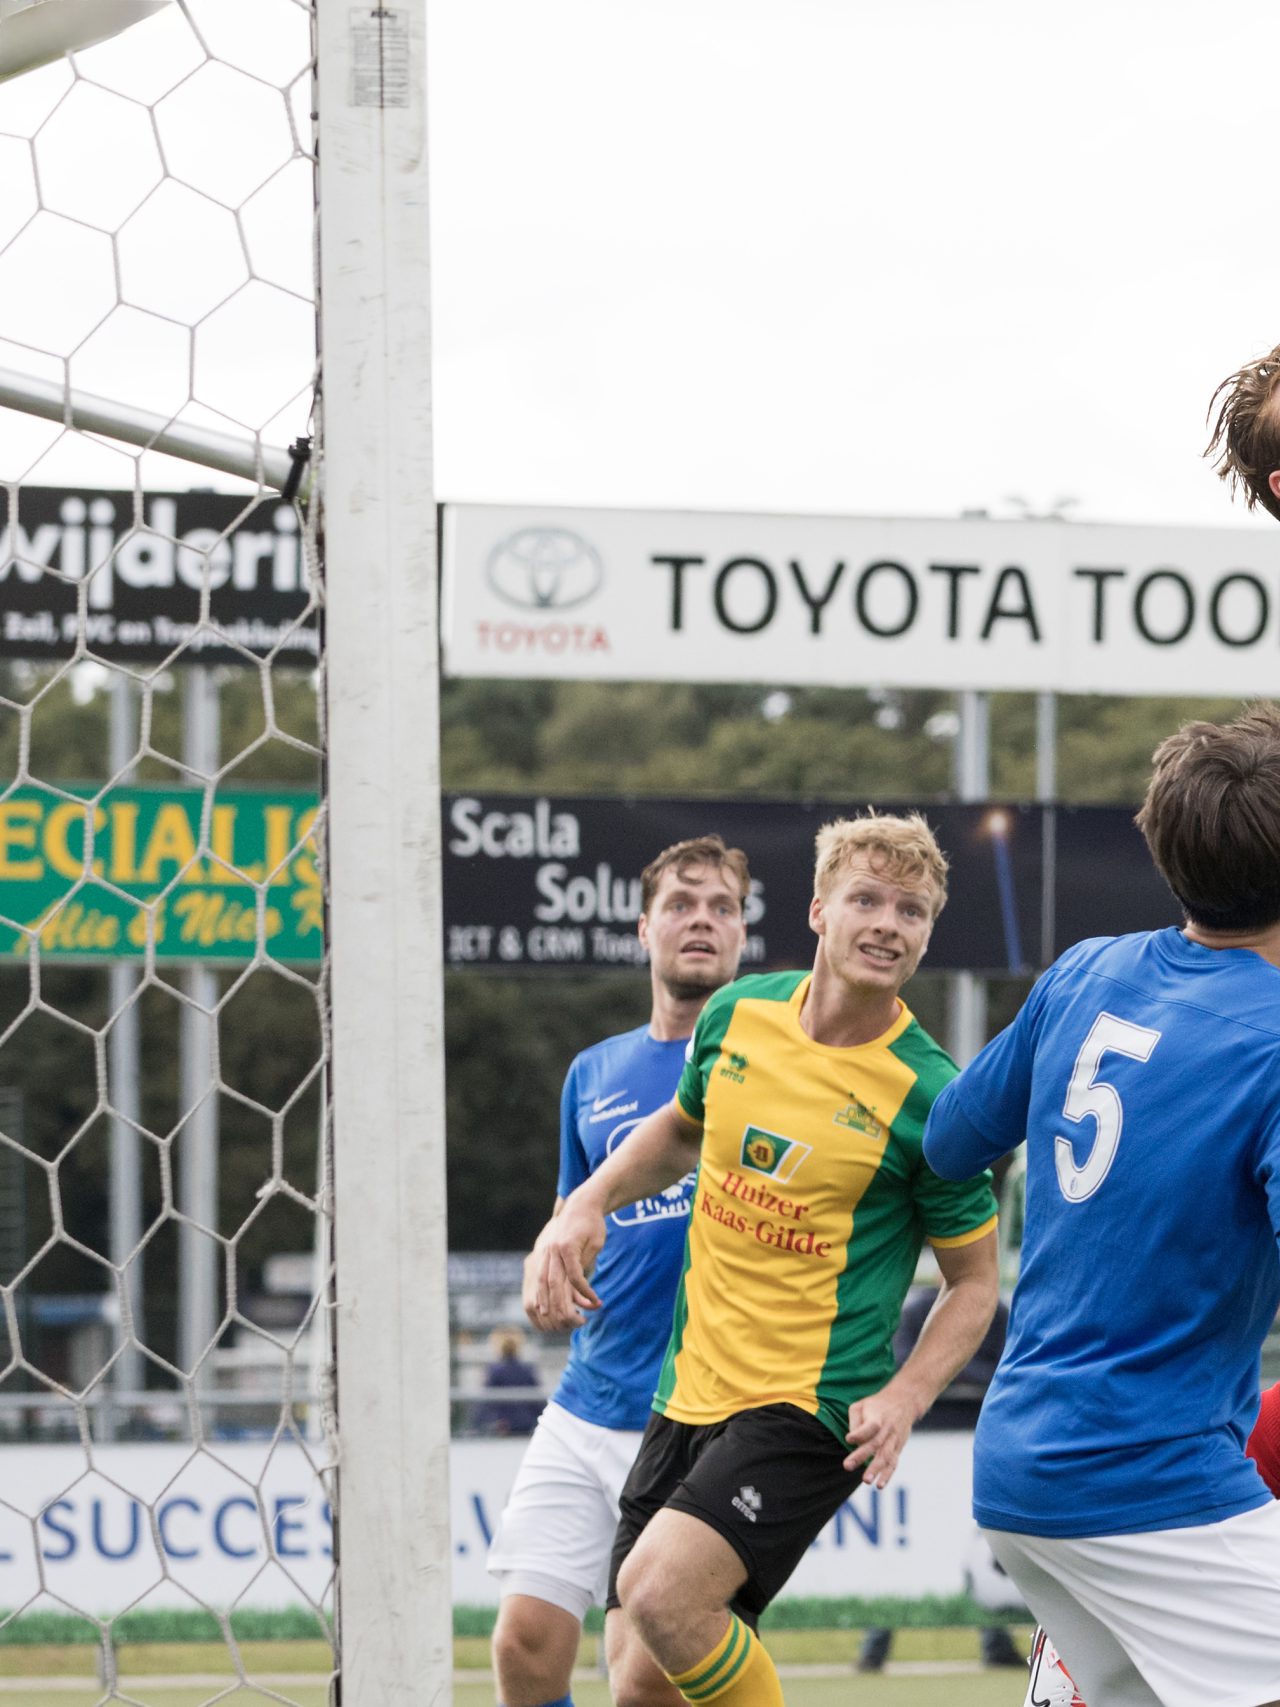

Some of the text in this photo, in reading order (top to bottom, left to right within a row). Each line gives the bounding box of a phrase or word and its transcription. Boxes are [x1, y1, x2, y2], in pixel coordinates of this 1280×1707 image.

[651, 555, 1043, 643] TOYOTA
[477, 619, 611, 653] TOYOTA
[450, 798, 581, 859] Scala
[1055, 1011, 1162, 1203] 5
[700, 1190, 832, 1258] Kaas-Gilde
[721, 1171, 809, 1222] Huizer
